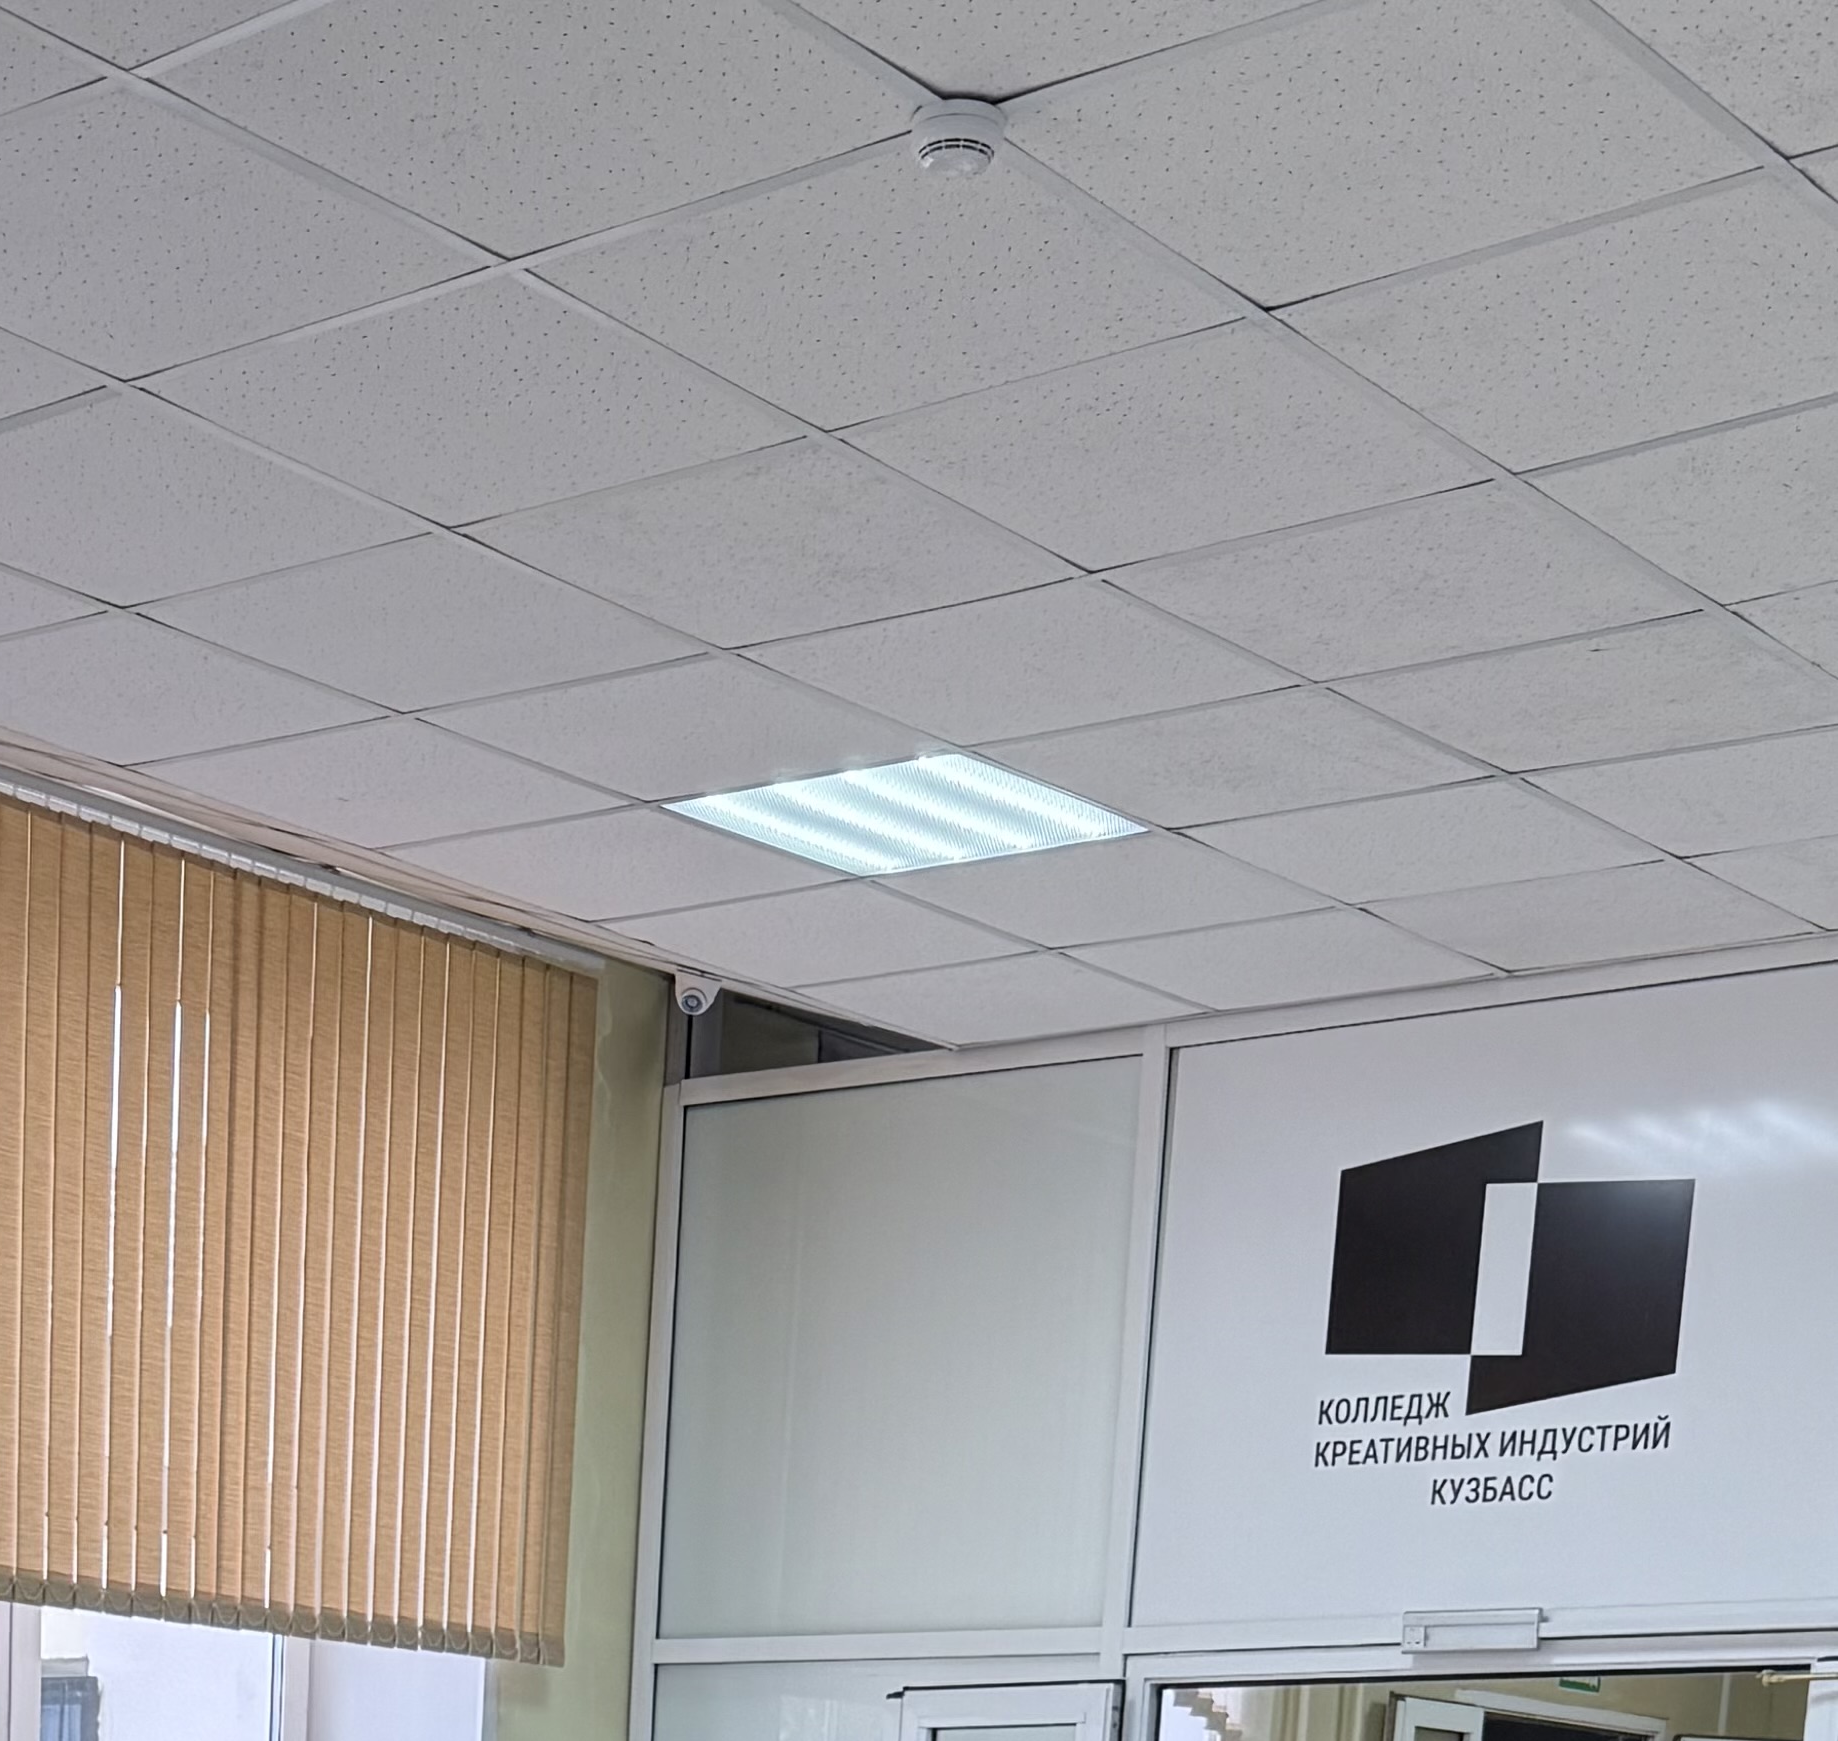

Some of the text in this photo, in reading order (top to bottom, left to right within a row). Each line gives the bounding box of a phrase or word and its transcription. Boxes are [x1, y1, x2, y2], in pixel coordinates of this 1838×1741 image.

[1317, 1391, 1451, 1426] КОЛЛЕДЖ
[1313, 1415, 1672, 1468] КРЕАТИВНЫХ ИНДУСТРИЙ
[1430, 1474, 1554, 1505] КУЗБАСС
